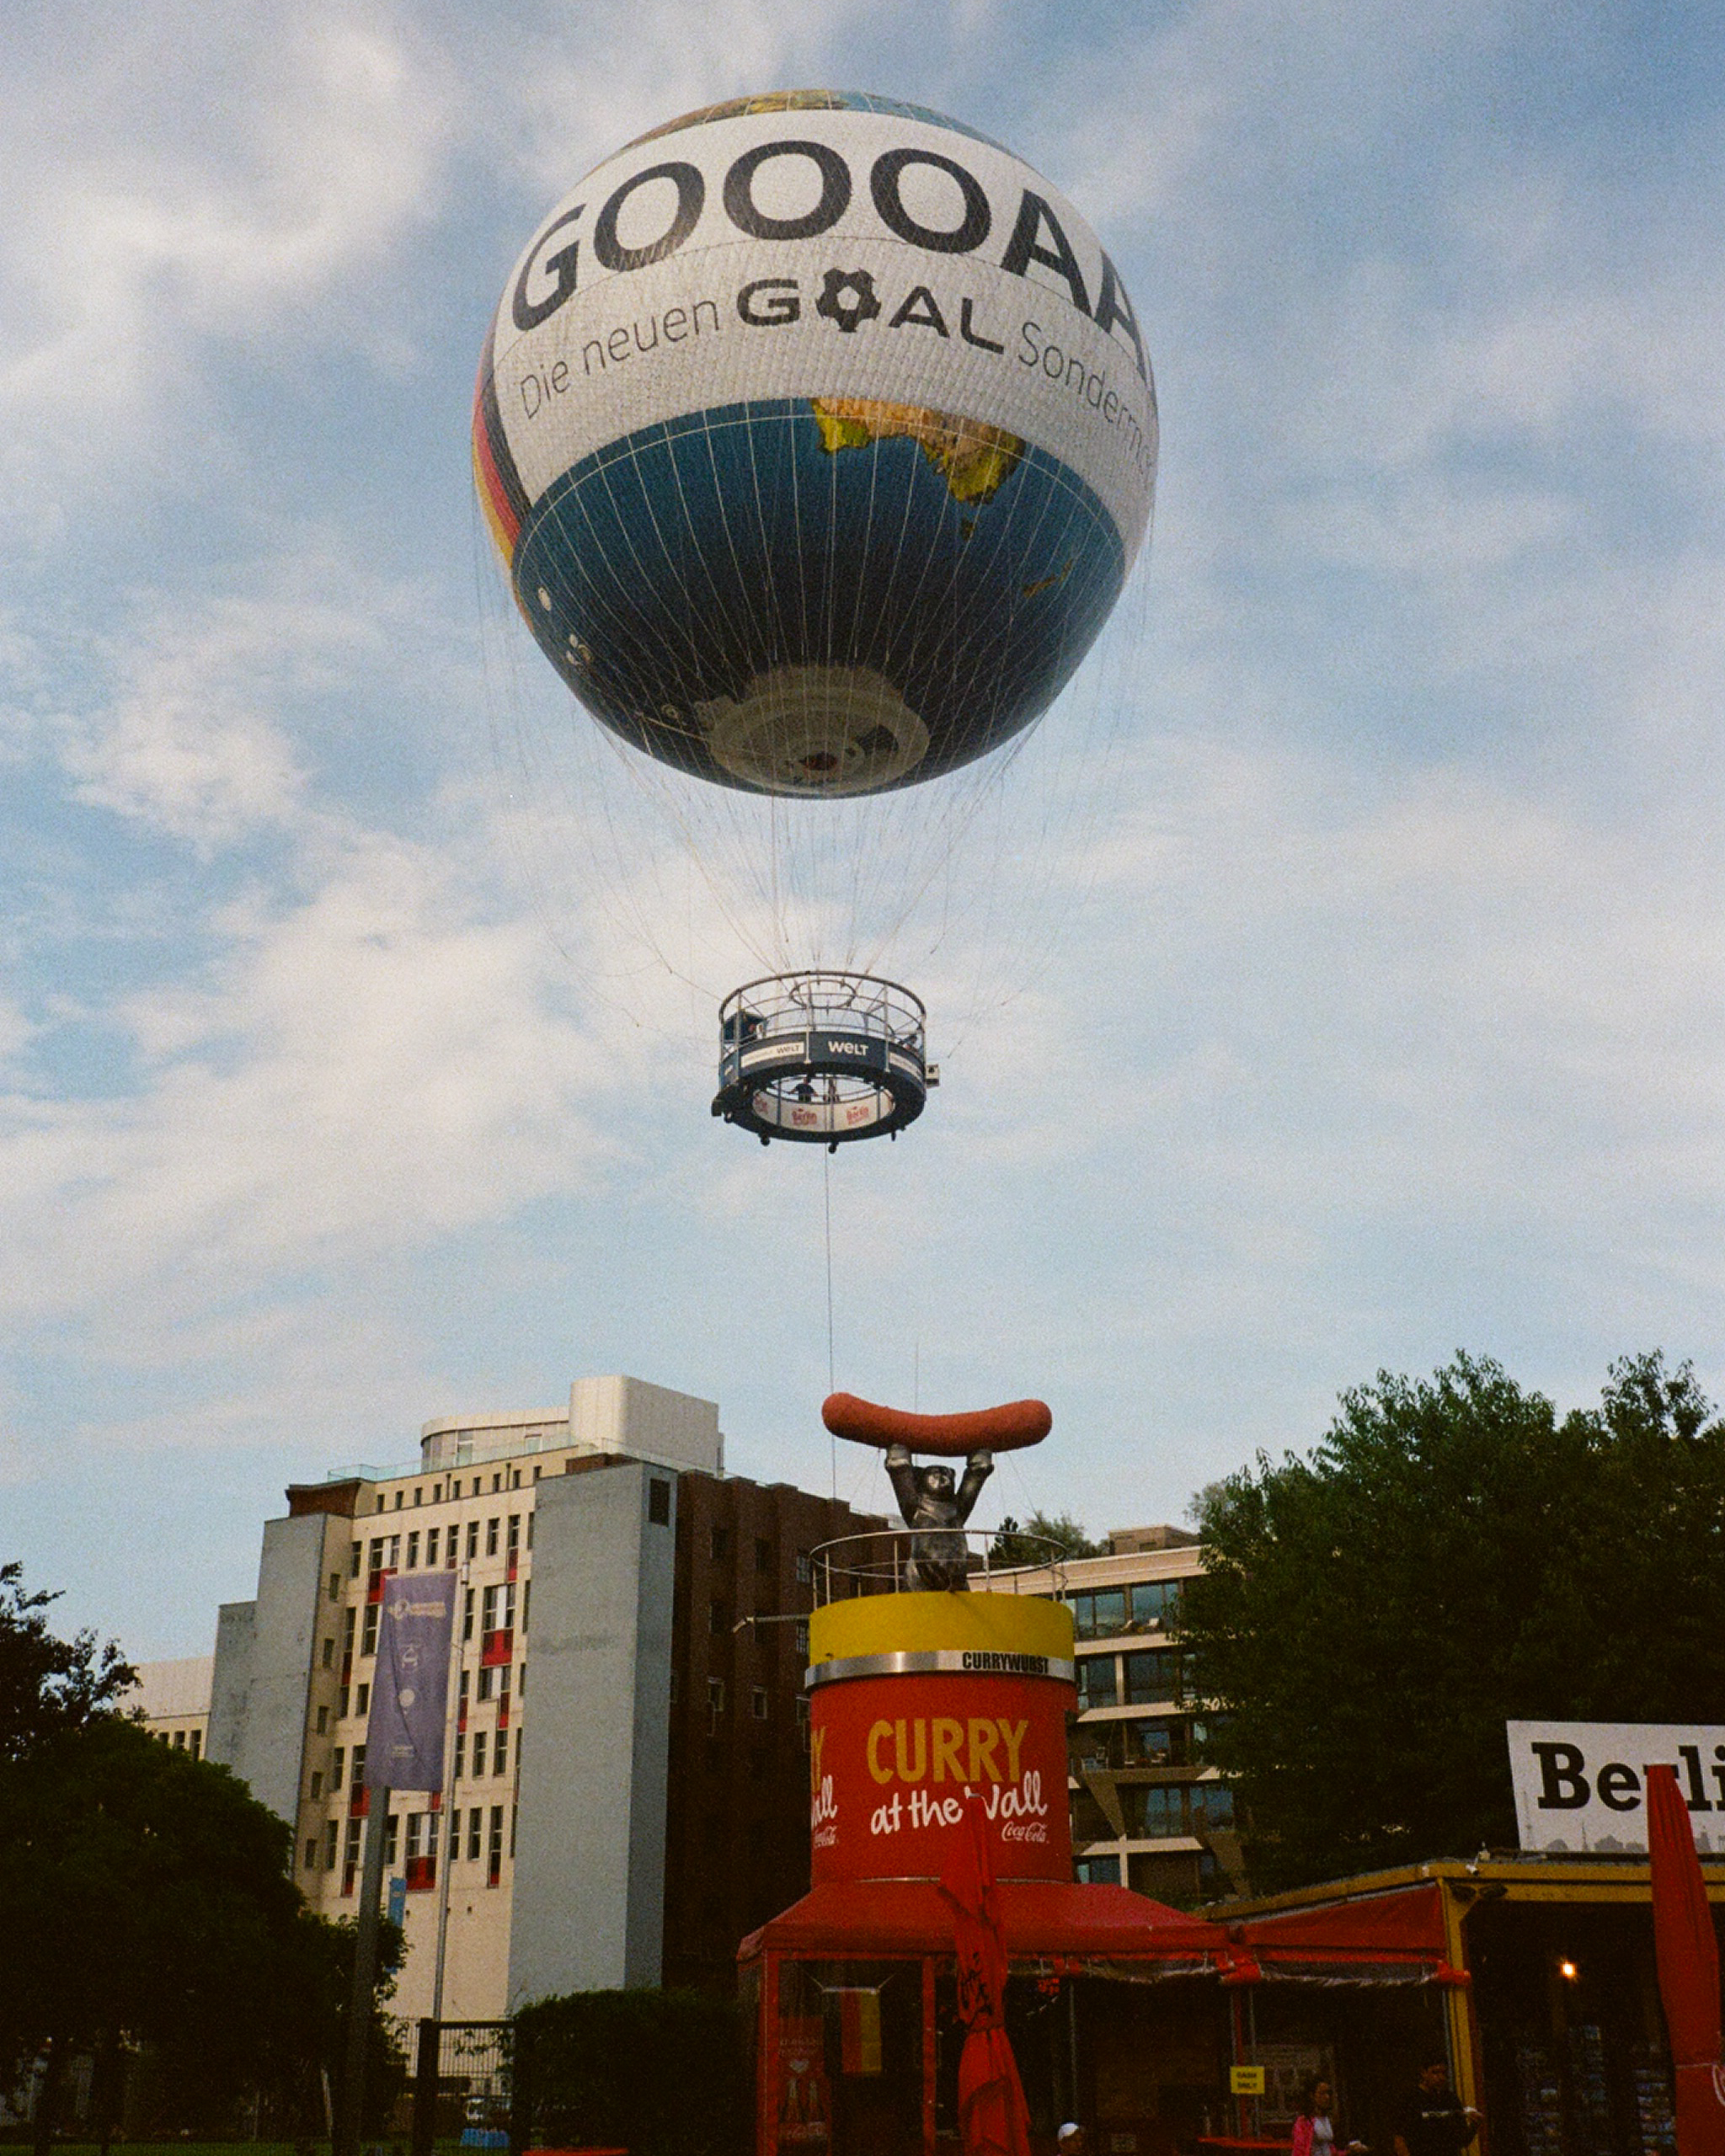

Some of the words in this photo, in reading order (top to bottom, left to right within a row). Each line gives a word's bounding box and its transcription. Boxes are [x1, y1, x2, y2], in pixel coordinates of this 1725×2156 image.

[520, 361, 571, 419] Die
[582, 301, 719, 376] neuen
[962, 1652, 1049, 1673] CURRYWURST
[867, 1718, 1029, 1784] CURRY
[1531, 1742, 1725, 1811] Beli
[871, 1793, 903, 1834] at
[908, 1790, 964, 1828] the
